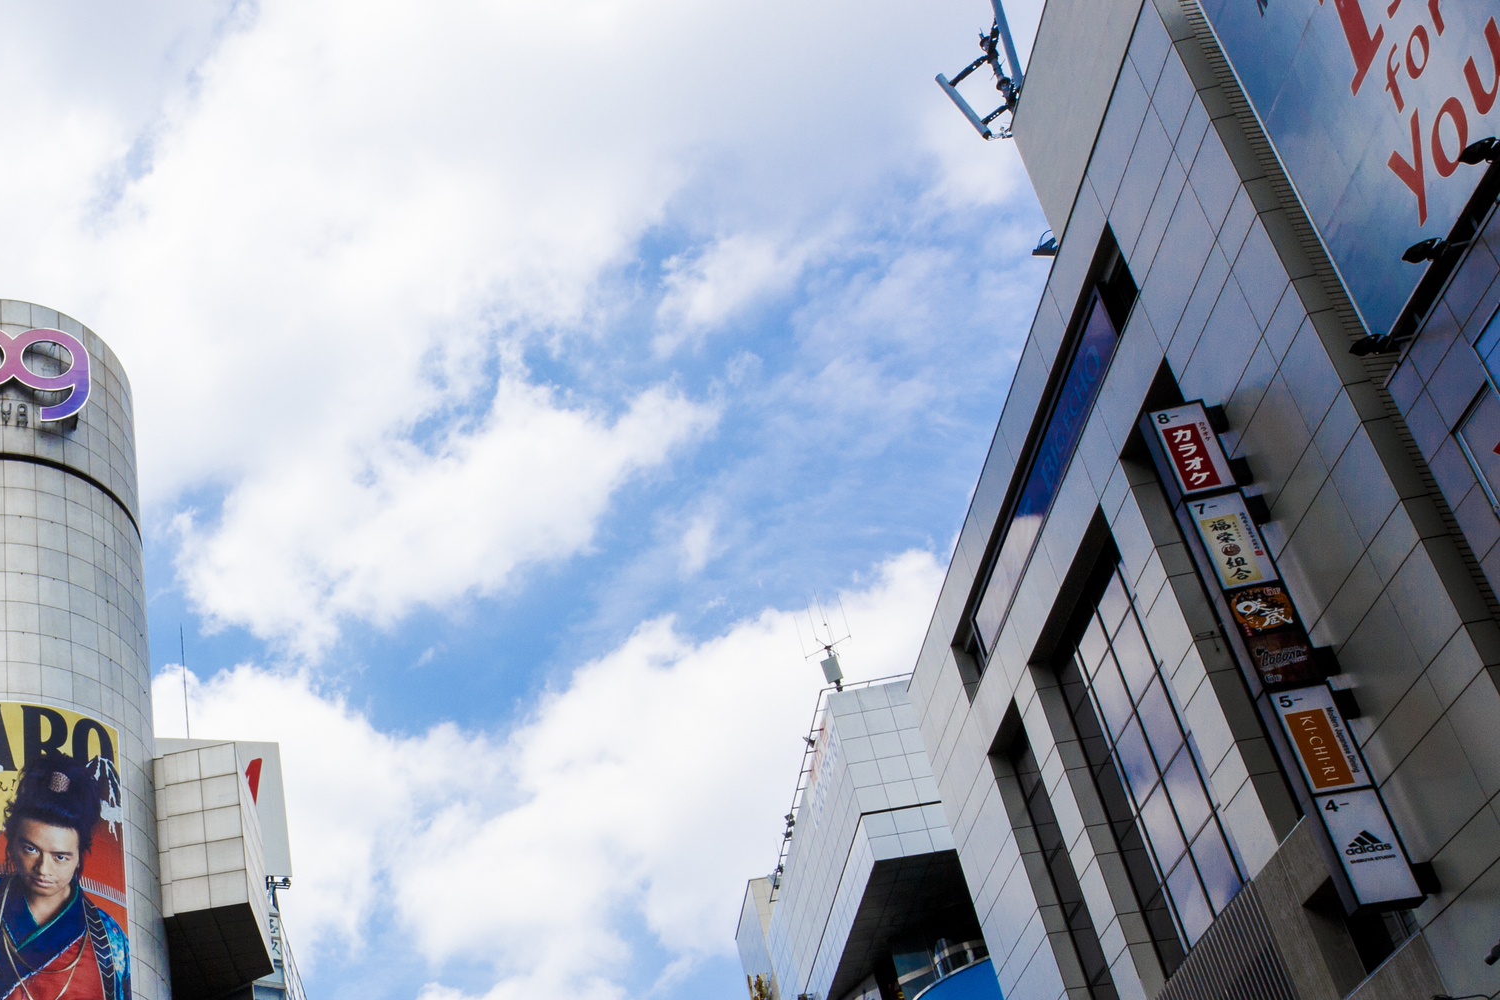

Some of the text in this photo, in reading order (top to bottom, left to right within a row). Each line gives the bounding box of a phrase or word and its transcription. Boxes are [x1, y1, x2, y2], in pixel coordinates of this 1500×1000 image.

[1172, 429, 1211, 486] カラオケ
[1345, 842, 1393, 856] adidas
